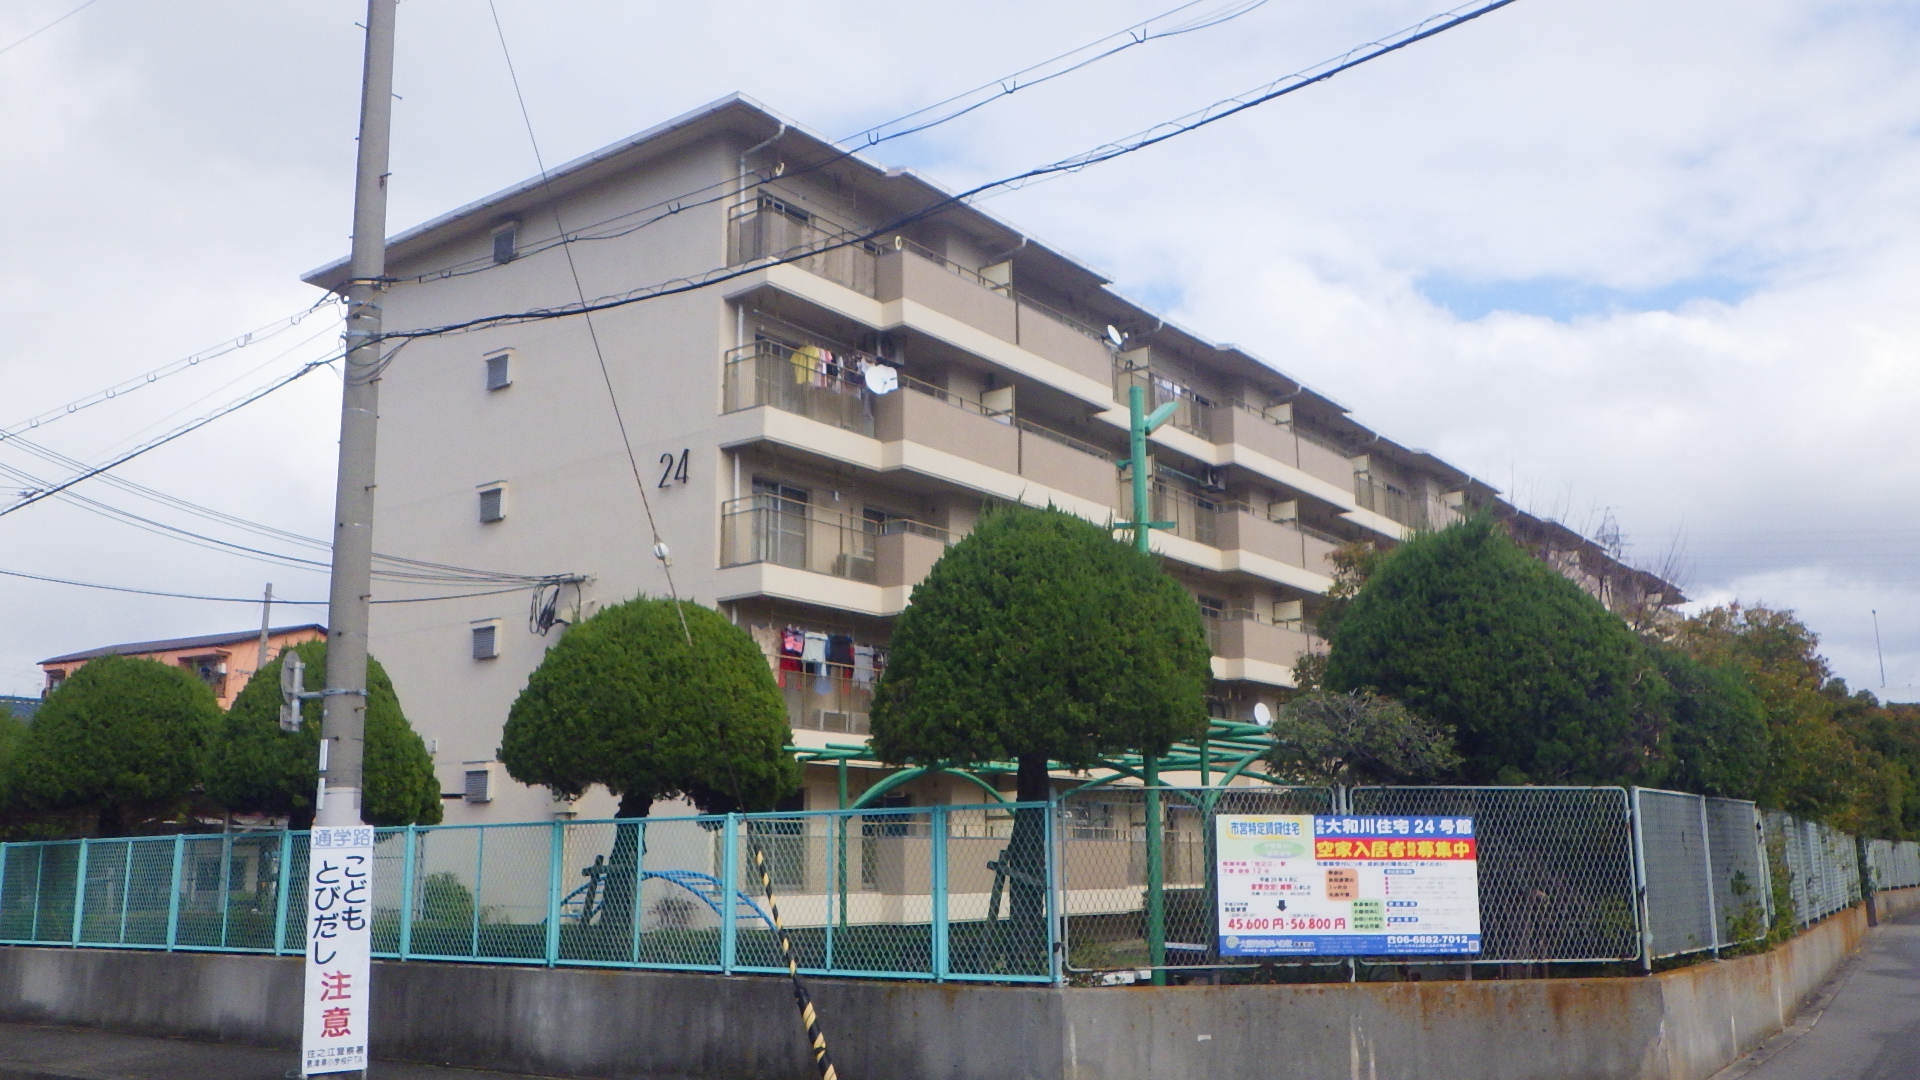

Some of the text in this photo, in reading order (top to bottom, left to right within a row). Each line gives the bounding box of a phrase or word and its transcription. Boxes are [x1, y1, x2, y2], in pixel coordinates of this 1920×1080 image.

[658, 449, 689, 488] 24
[1231, 822, 1300, 835] 市営特定賃貸住宅
[1326, 819, 1409, 835] 大和川住宅
[1414, 820, 1435, 833] 24
[1439, 819, 1472, 835] 号館
[314, 828, 372, 847] 通学路
[1316, 841, 1406, 857] 空家入居者
[1417, 841, 1470, 857] 募集中
[341, 855, 366, 931] こども
[312, 860, 341, 965] とびだし
[1272, 918, 1284, 930] 円
[1334, 918, 1346, 930] 円
[1396, 935, 1468, 944] 06-6882-7012
[320, 970, 352, 1038] 注意
